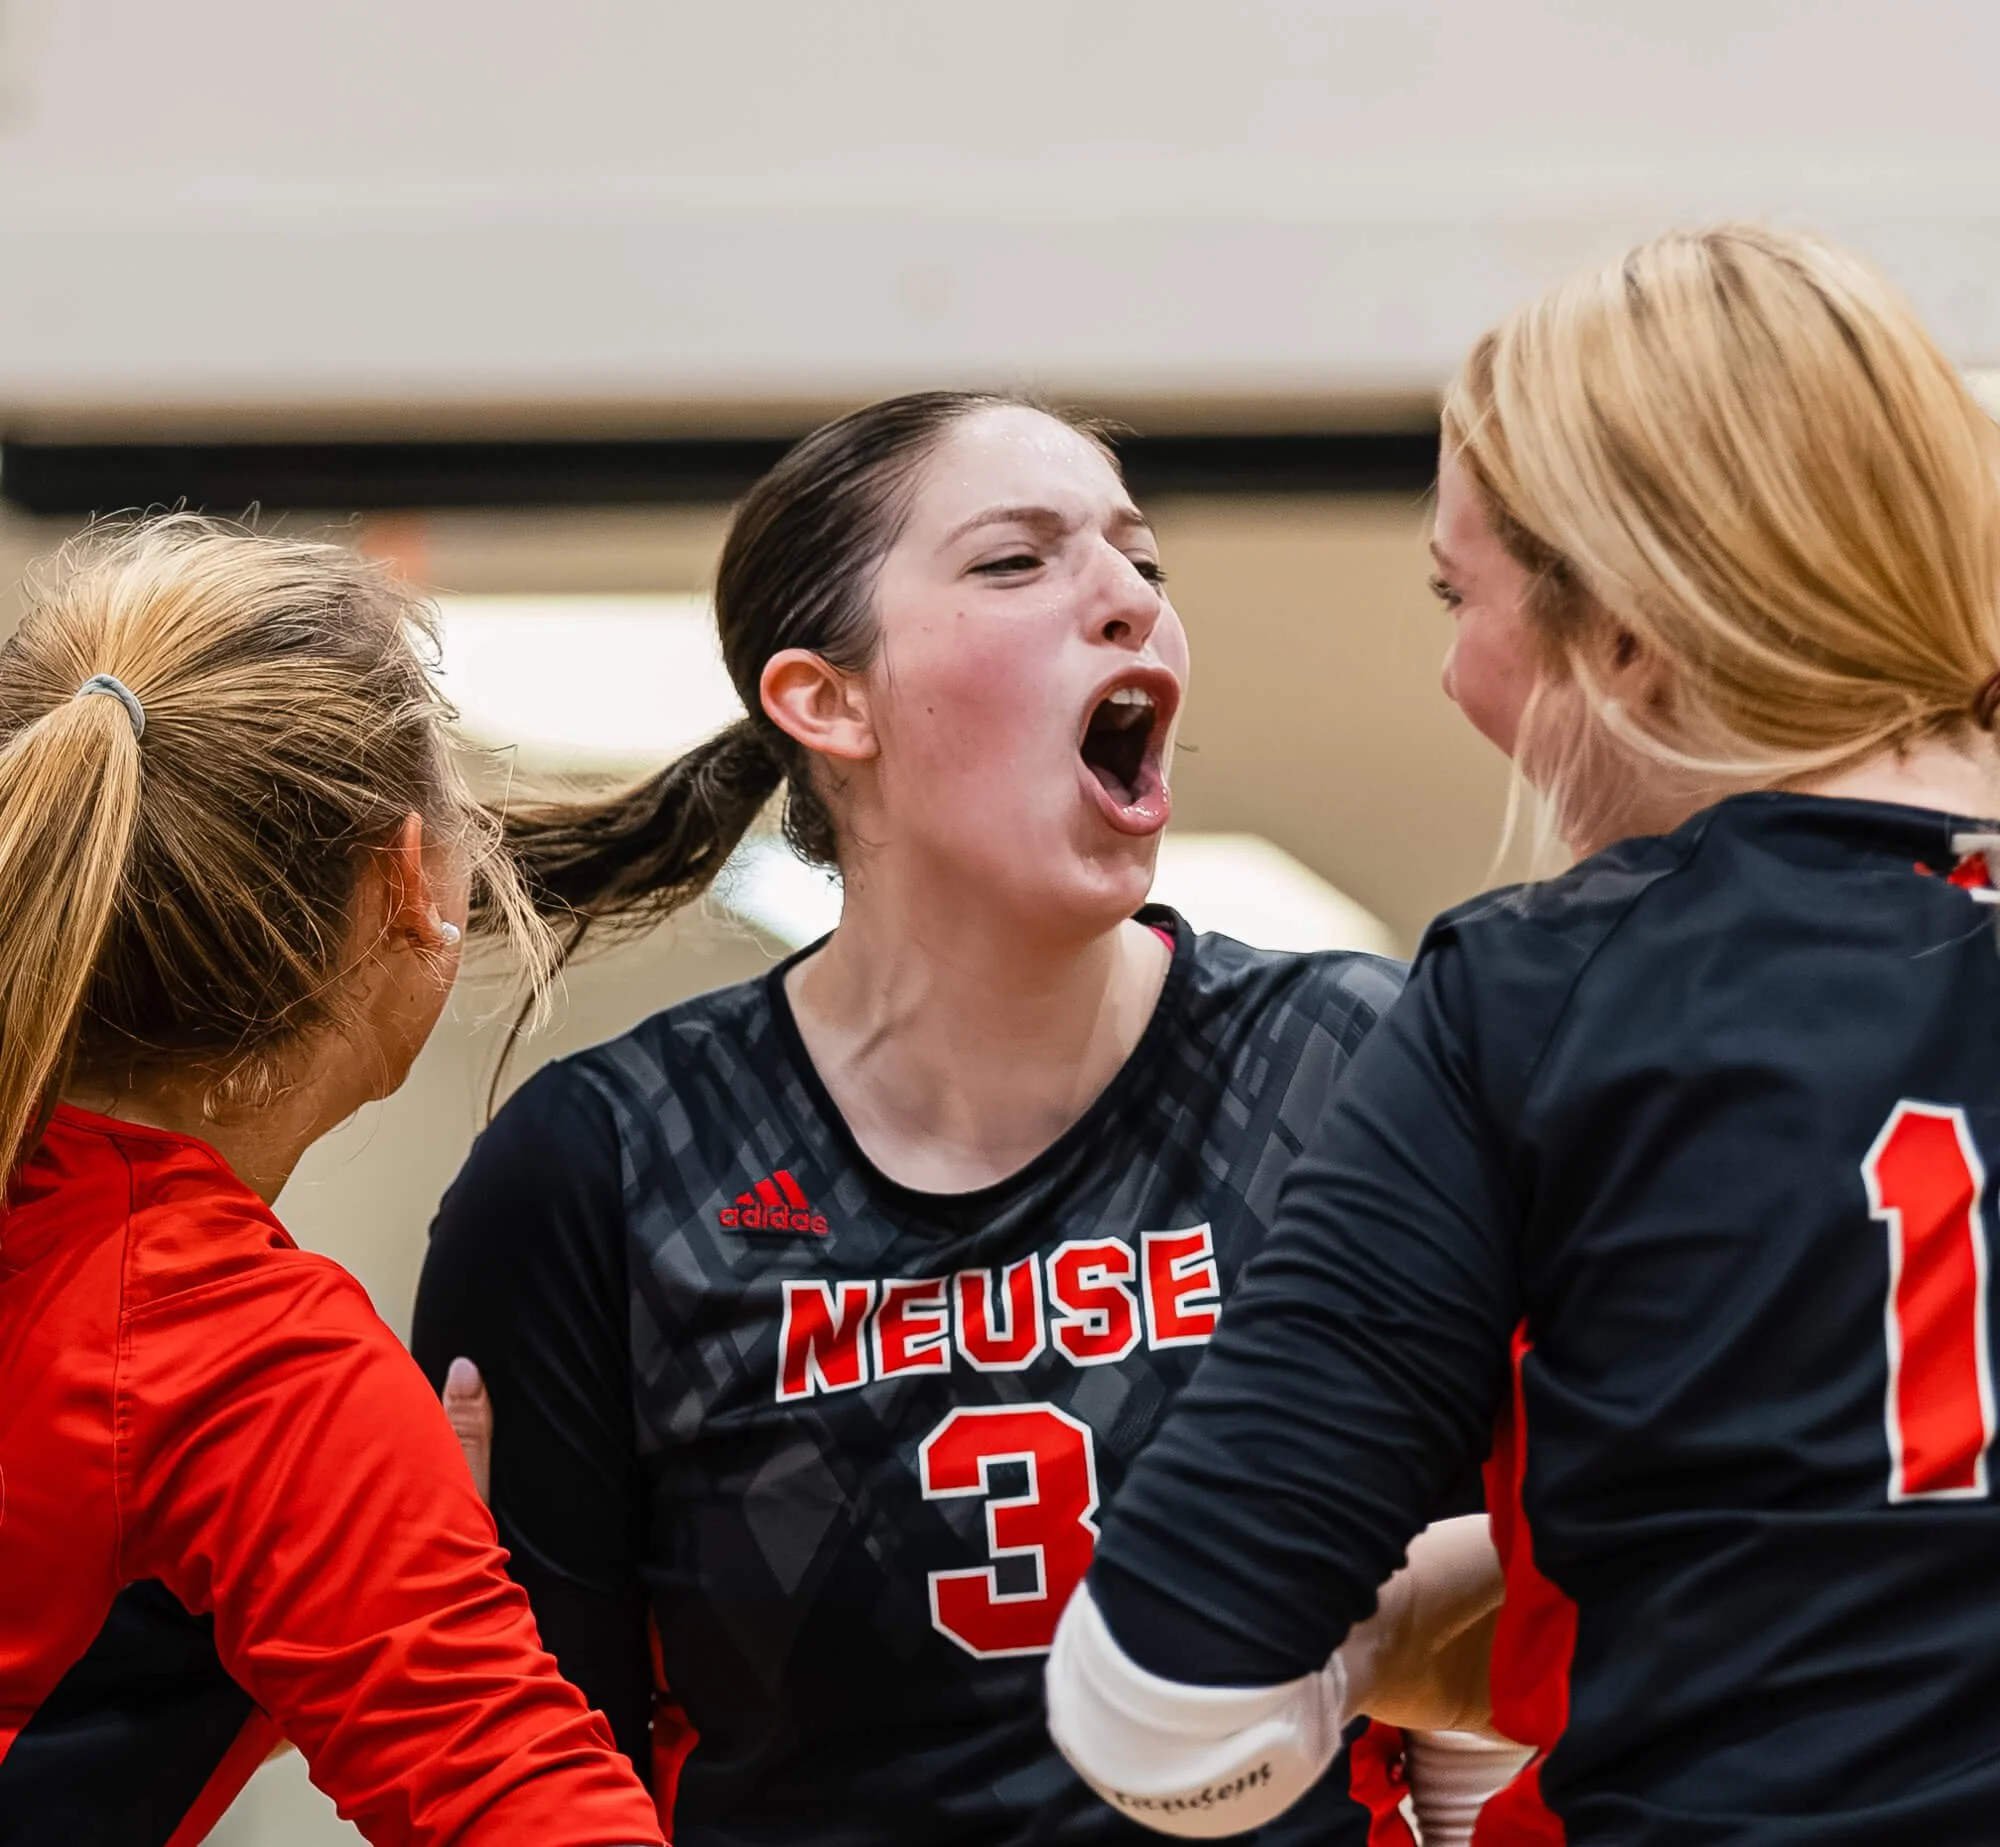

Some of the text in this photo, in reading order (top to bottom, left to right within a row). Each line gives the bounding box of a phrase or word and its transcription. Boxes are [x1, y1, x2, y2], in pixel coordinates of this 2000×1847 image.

[719, 1202, 830, 1236] adidas
[775, 1222, 1222, 1403] NEUSE
[1860, 1098, 2000, 1504] 1
[918, 1402, 1101, 1660] 3
